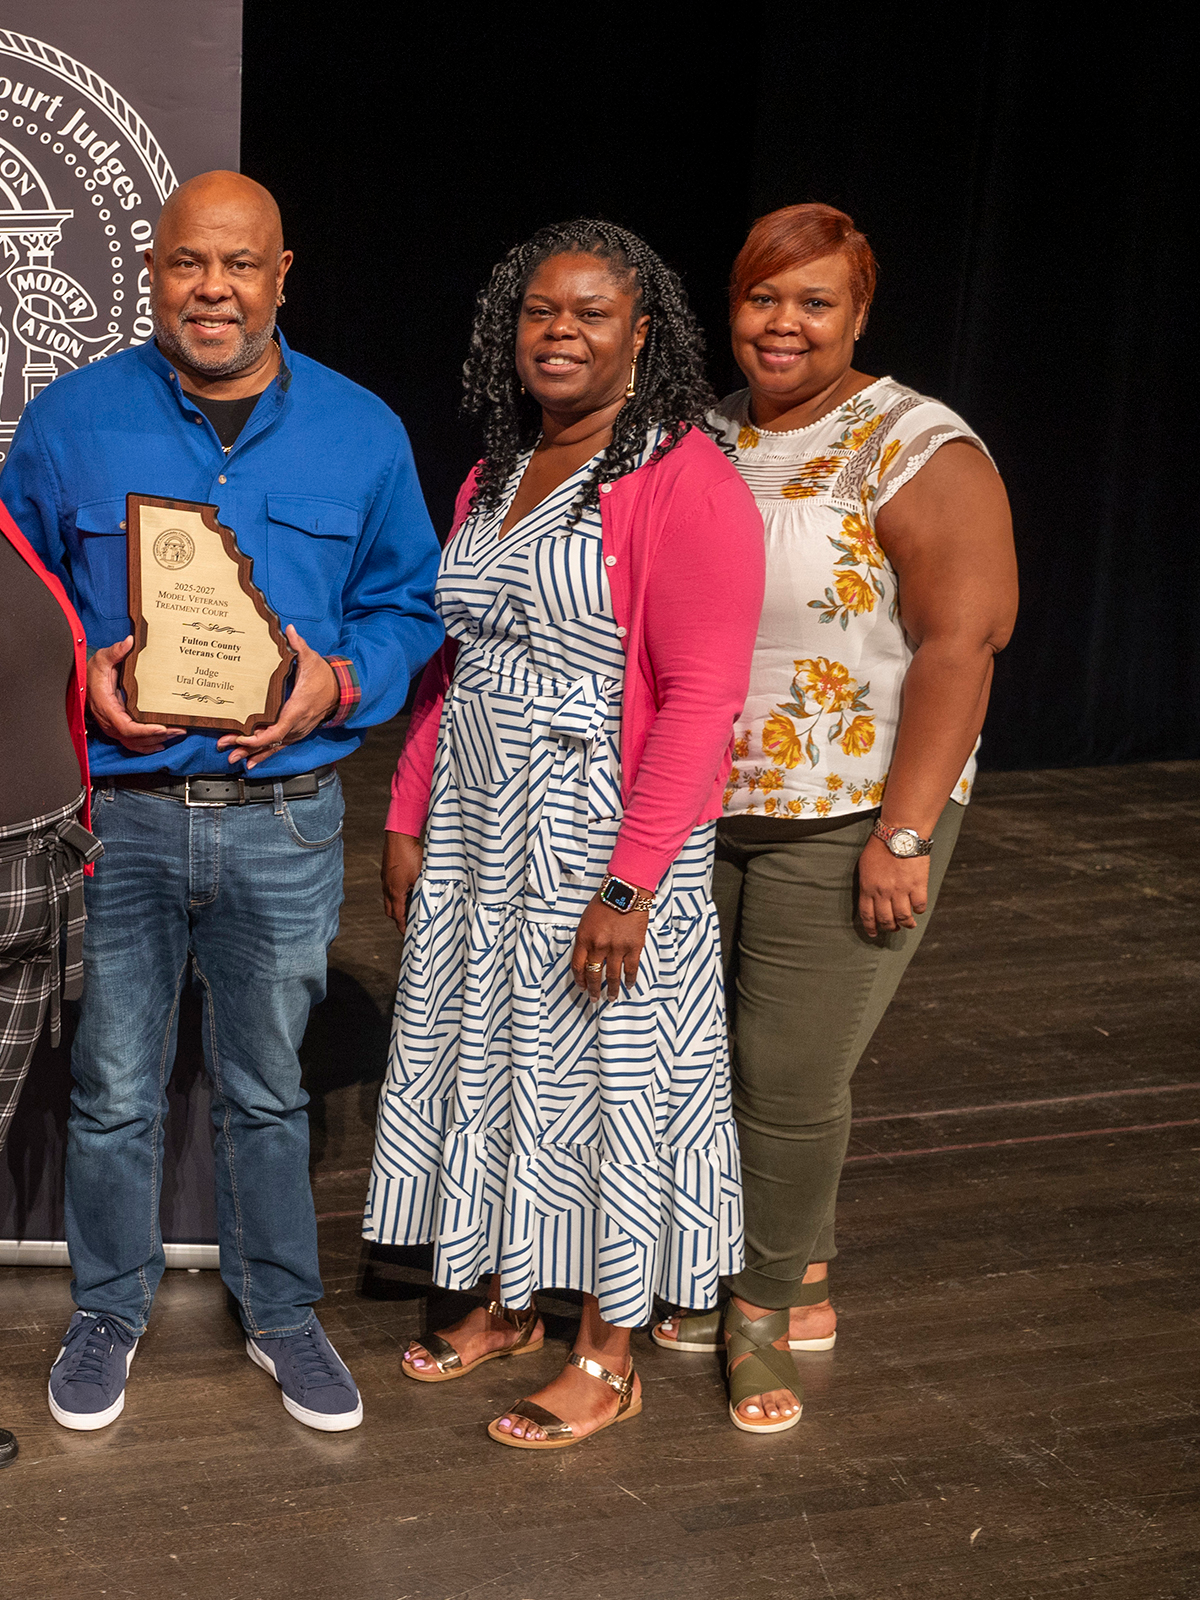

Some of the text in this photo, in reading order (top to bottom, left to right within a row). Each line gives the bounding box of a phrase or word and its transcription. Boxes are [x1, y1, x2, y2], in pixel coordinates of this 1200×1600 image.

[57, 107, 142, 211] Judges
[16, 271, 88, 317] MODER
[20, 317, 84, 358] ATION
[174, 582, 215, 595] 2025-2027
[179, 645, 241, 662] Veterans Court
[181, 635, 242, 654] Fulton County
[194, 666, 219, 679] Judge
[176, 674, 235, 691] Ural Glanville
